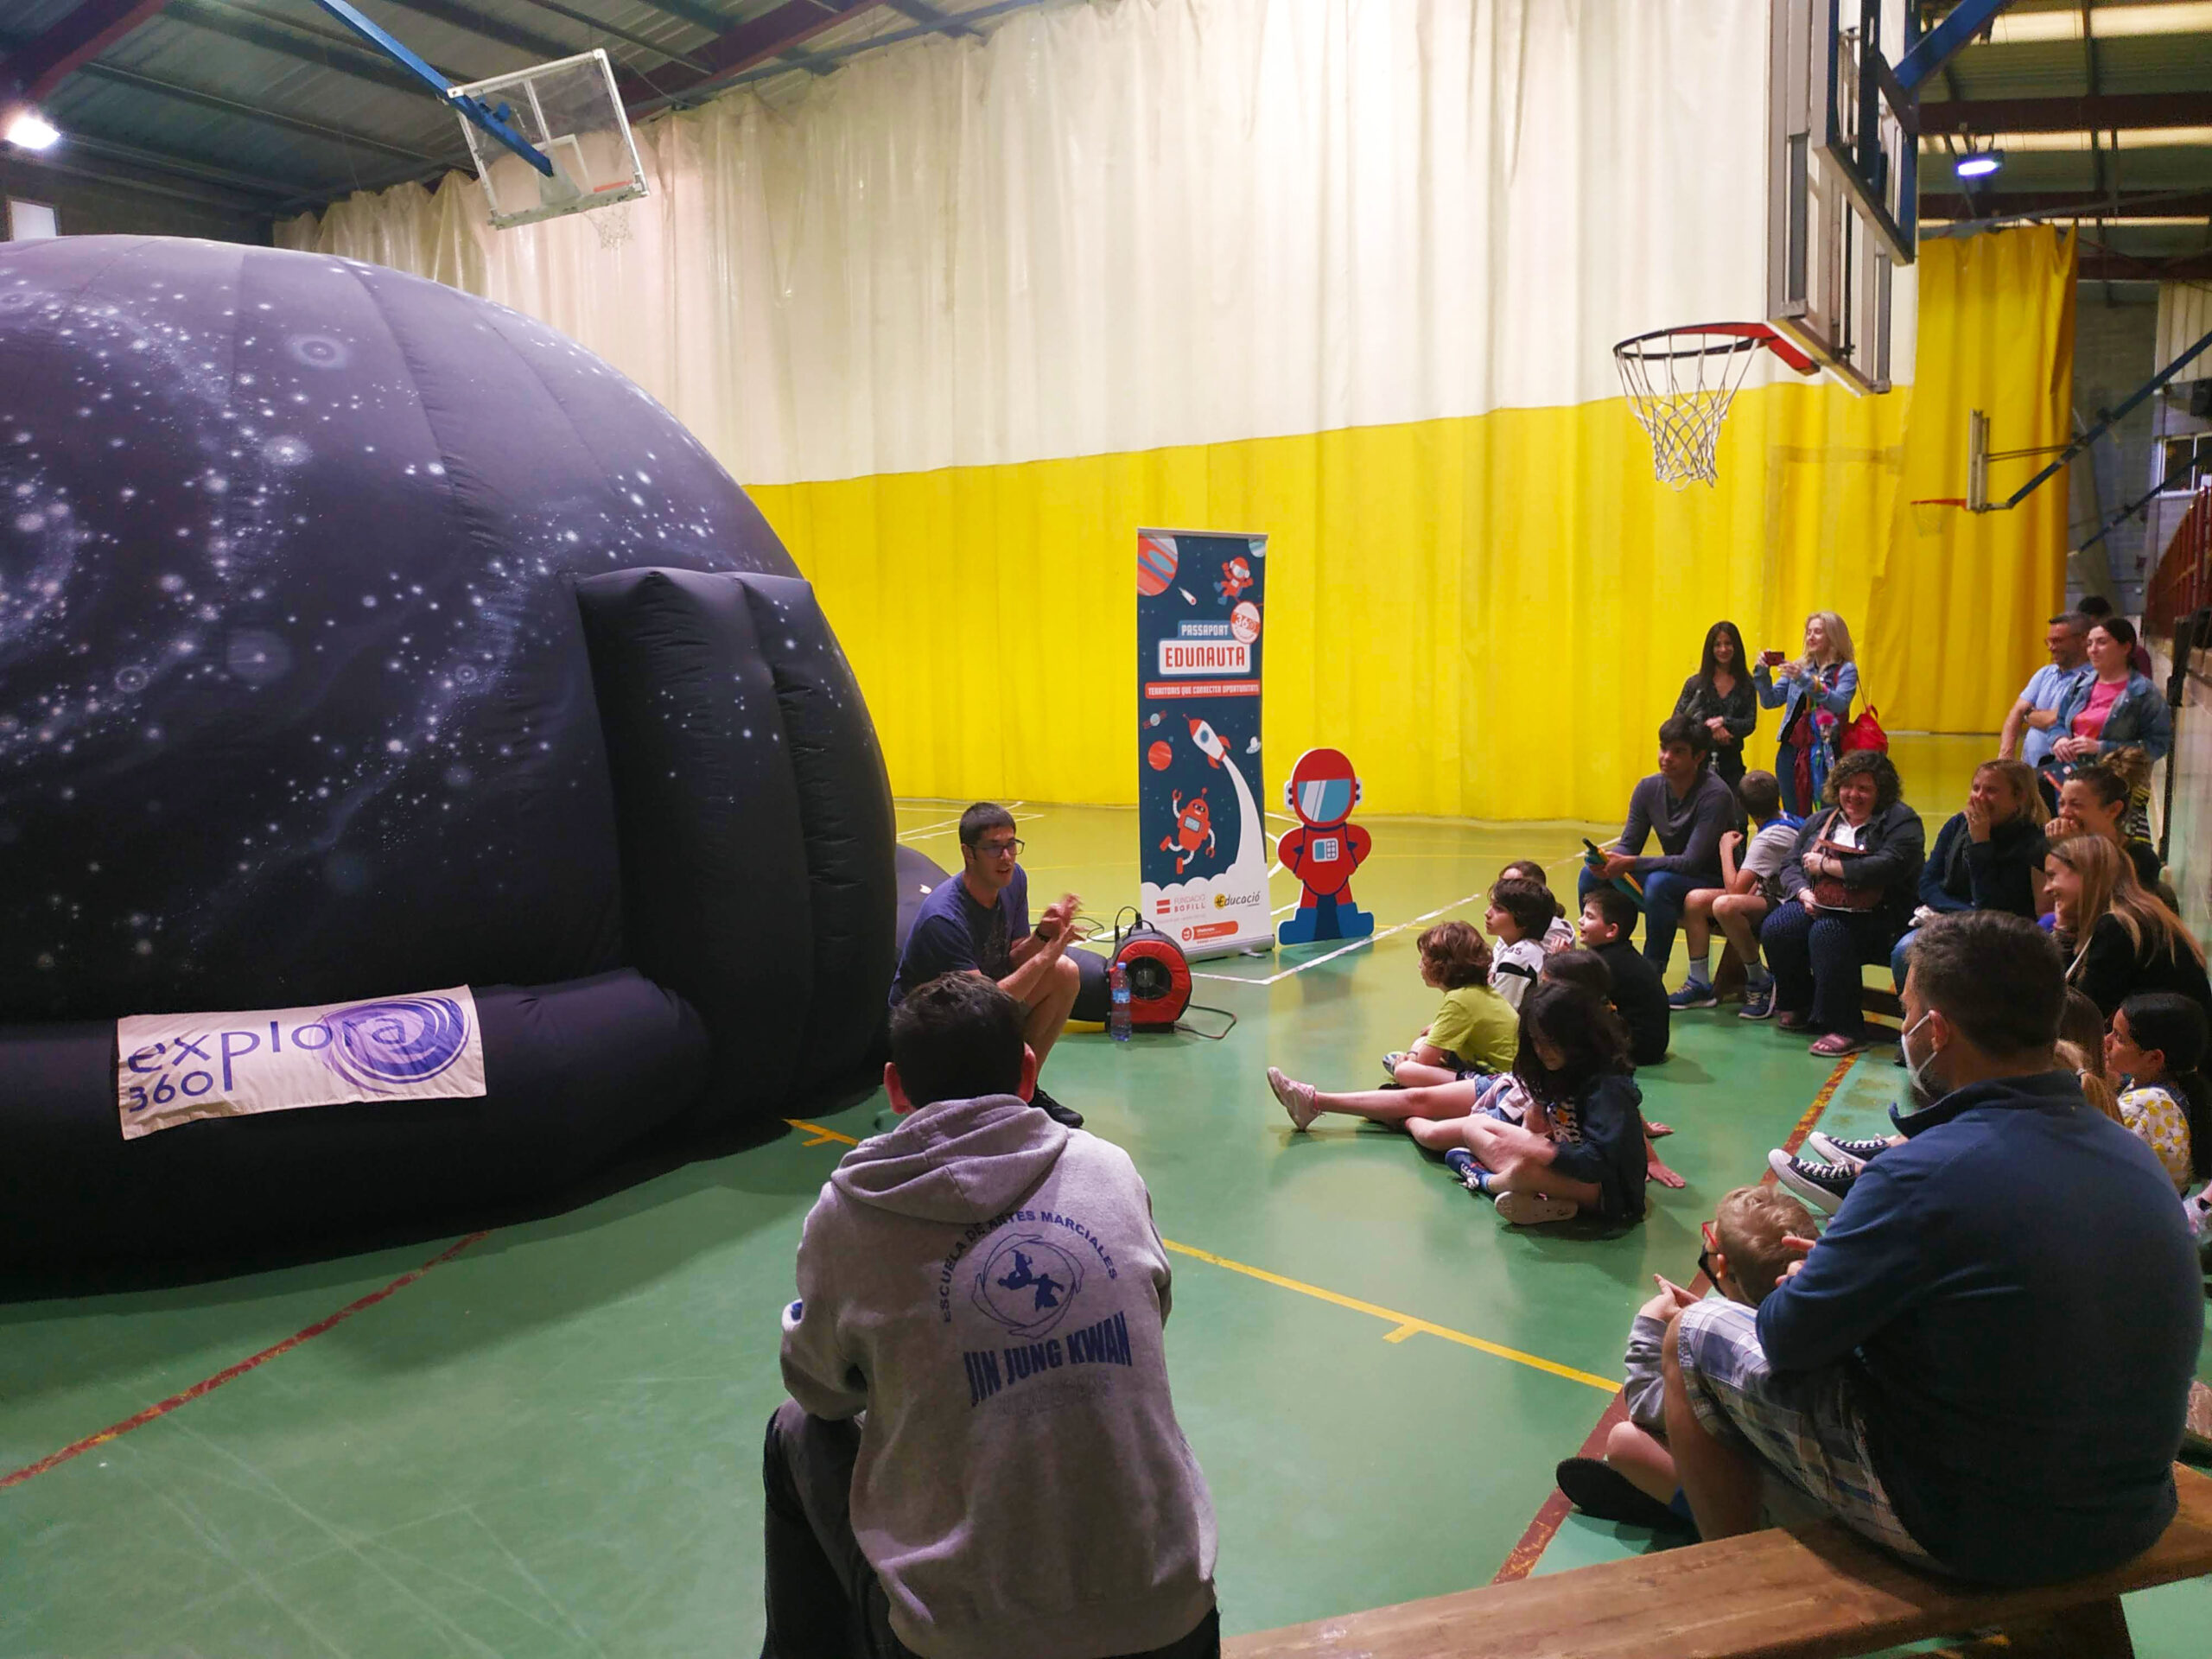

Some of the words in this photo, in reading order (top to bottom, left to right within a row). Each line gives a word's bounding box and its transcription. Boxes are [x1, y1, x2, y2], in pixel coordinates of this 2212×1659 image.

[1181, 624, 1229, 637] PASSAPORT
[1166, 646, 1245, 668] EDUNAUTA
[1174, 903, 1205, 912] BOFILL
[128, 1071, 214, 1113] 360
[939, 1242, 967, 1323] ESCUELA
[1041, 1211, 1118, 1280] MARCIALES
[963, 1350, 1001, 1408] JIN
[1004, 1339, 1063, 1385] JUNG
[1066, 1311, 1133, 1367] KWAN
